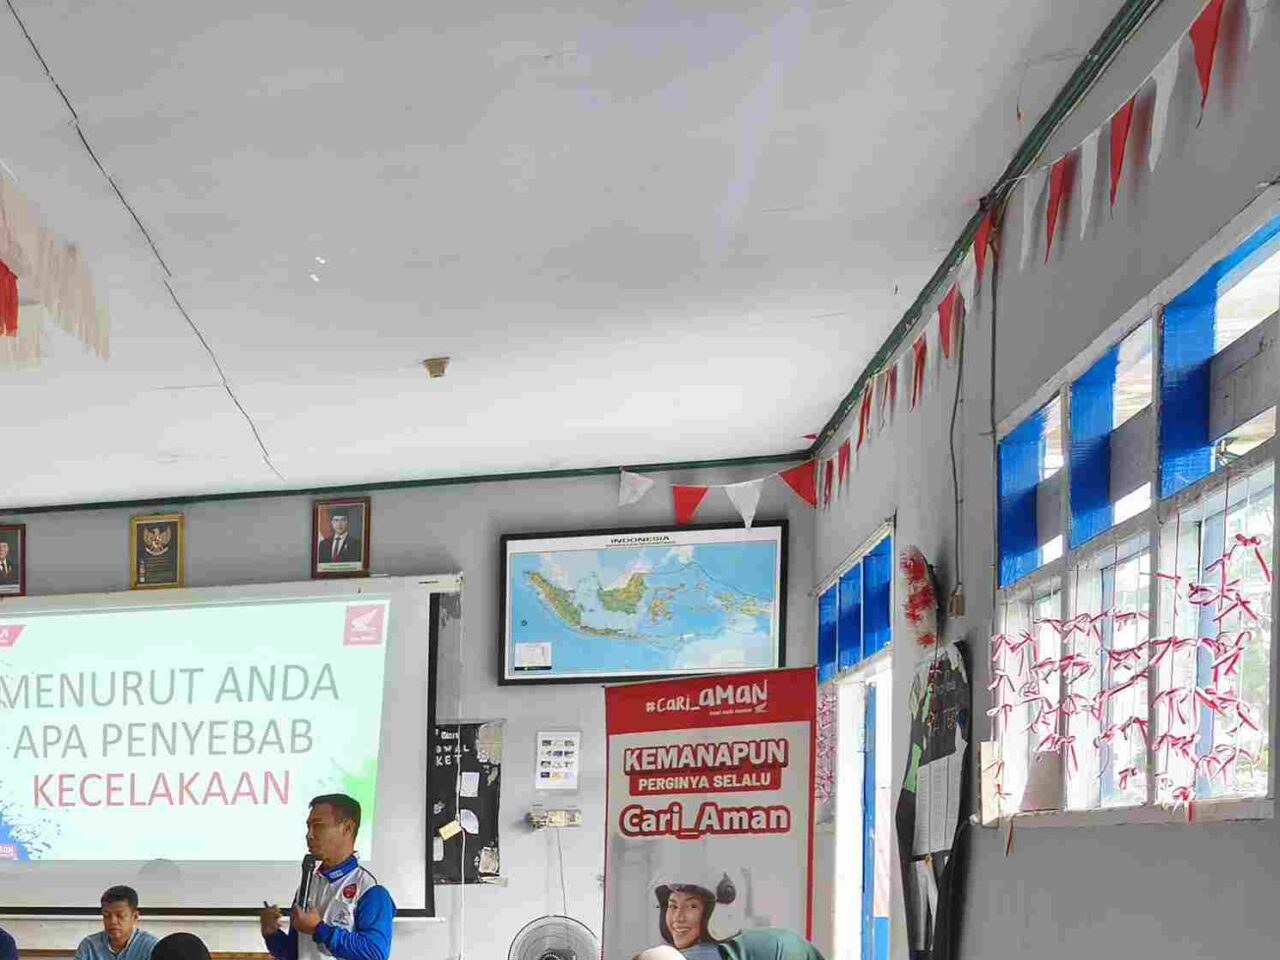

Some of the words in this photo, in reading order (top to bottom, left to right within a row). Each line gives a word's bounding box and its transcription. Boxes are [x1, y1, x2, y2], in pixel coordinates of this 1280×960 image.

[214, 663, 339, 704] ANDA
[13, 724, 88, 759] APA
[102, 718, 313, 758] PENYEBAB
[624, 740, 787, 772] KEMANAPUN
[33, 770, 290, 807] KECELAKAAN
[638, 775, 709, 791] PERGINYA
[713, 772, 771, 788] SELALU
[622, 804, 789, 836] Cari_Aman
